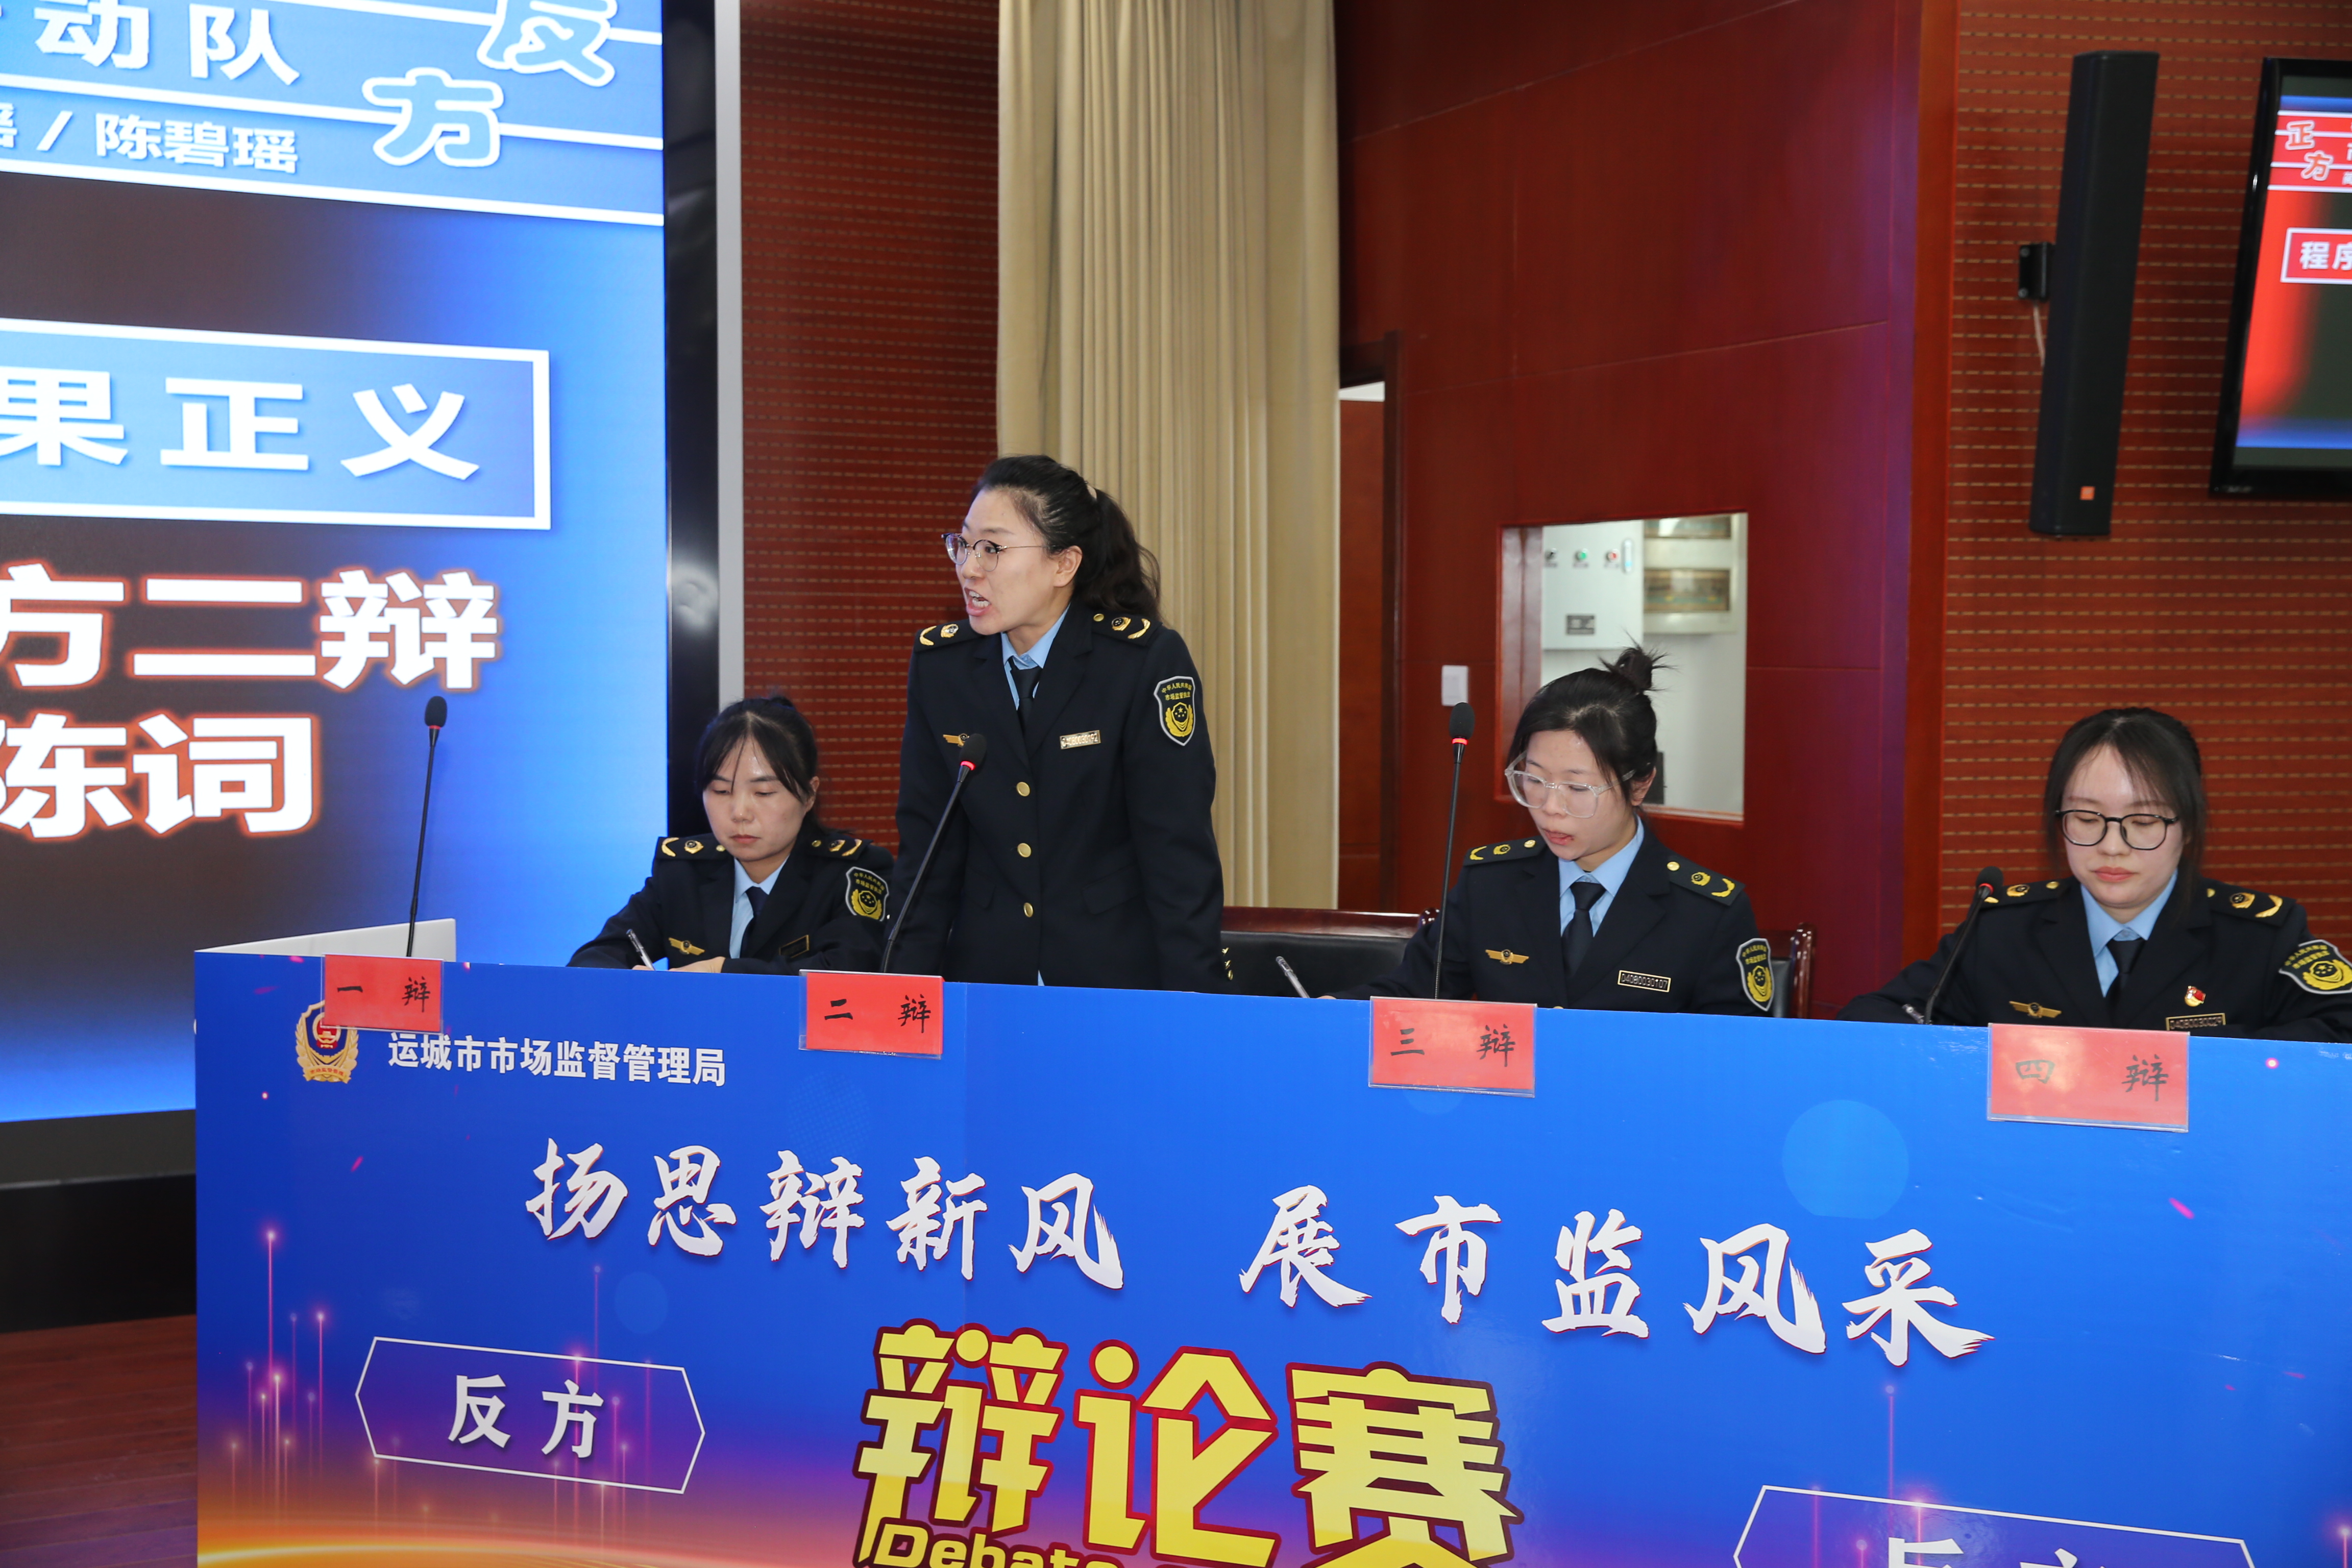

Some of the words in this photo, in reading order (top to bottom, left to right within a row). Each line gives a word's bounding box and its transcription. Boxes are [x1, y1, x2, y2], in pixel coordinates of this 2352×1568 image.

[96, 113, 298, 174] 陈碧瑶
[2285, 119, 2335, 181] 正方
[0, 365, 480, 480] 果正义
[0, 563, 498, 689] 方二辩
[388, 1032, 726, 1087] 运城市市场监督管理局
[525, 1137, 1123, 1290] 扬思辩新风
[1238, 1184, 1996, 1367] 展市监风采
[448, 1374, 604, 1458] 反方
[856, 1324, 1518, 1568] 辩论赛
